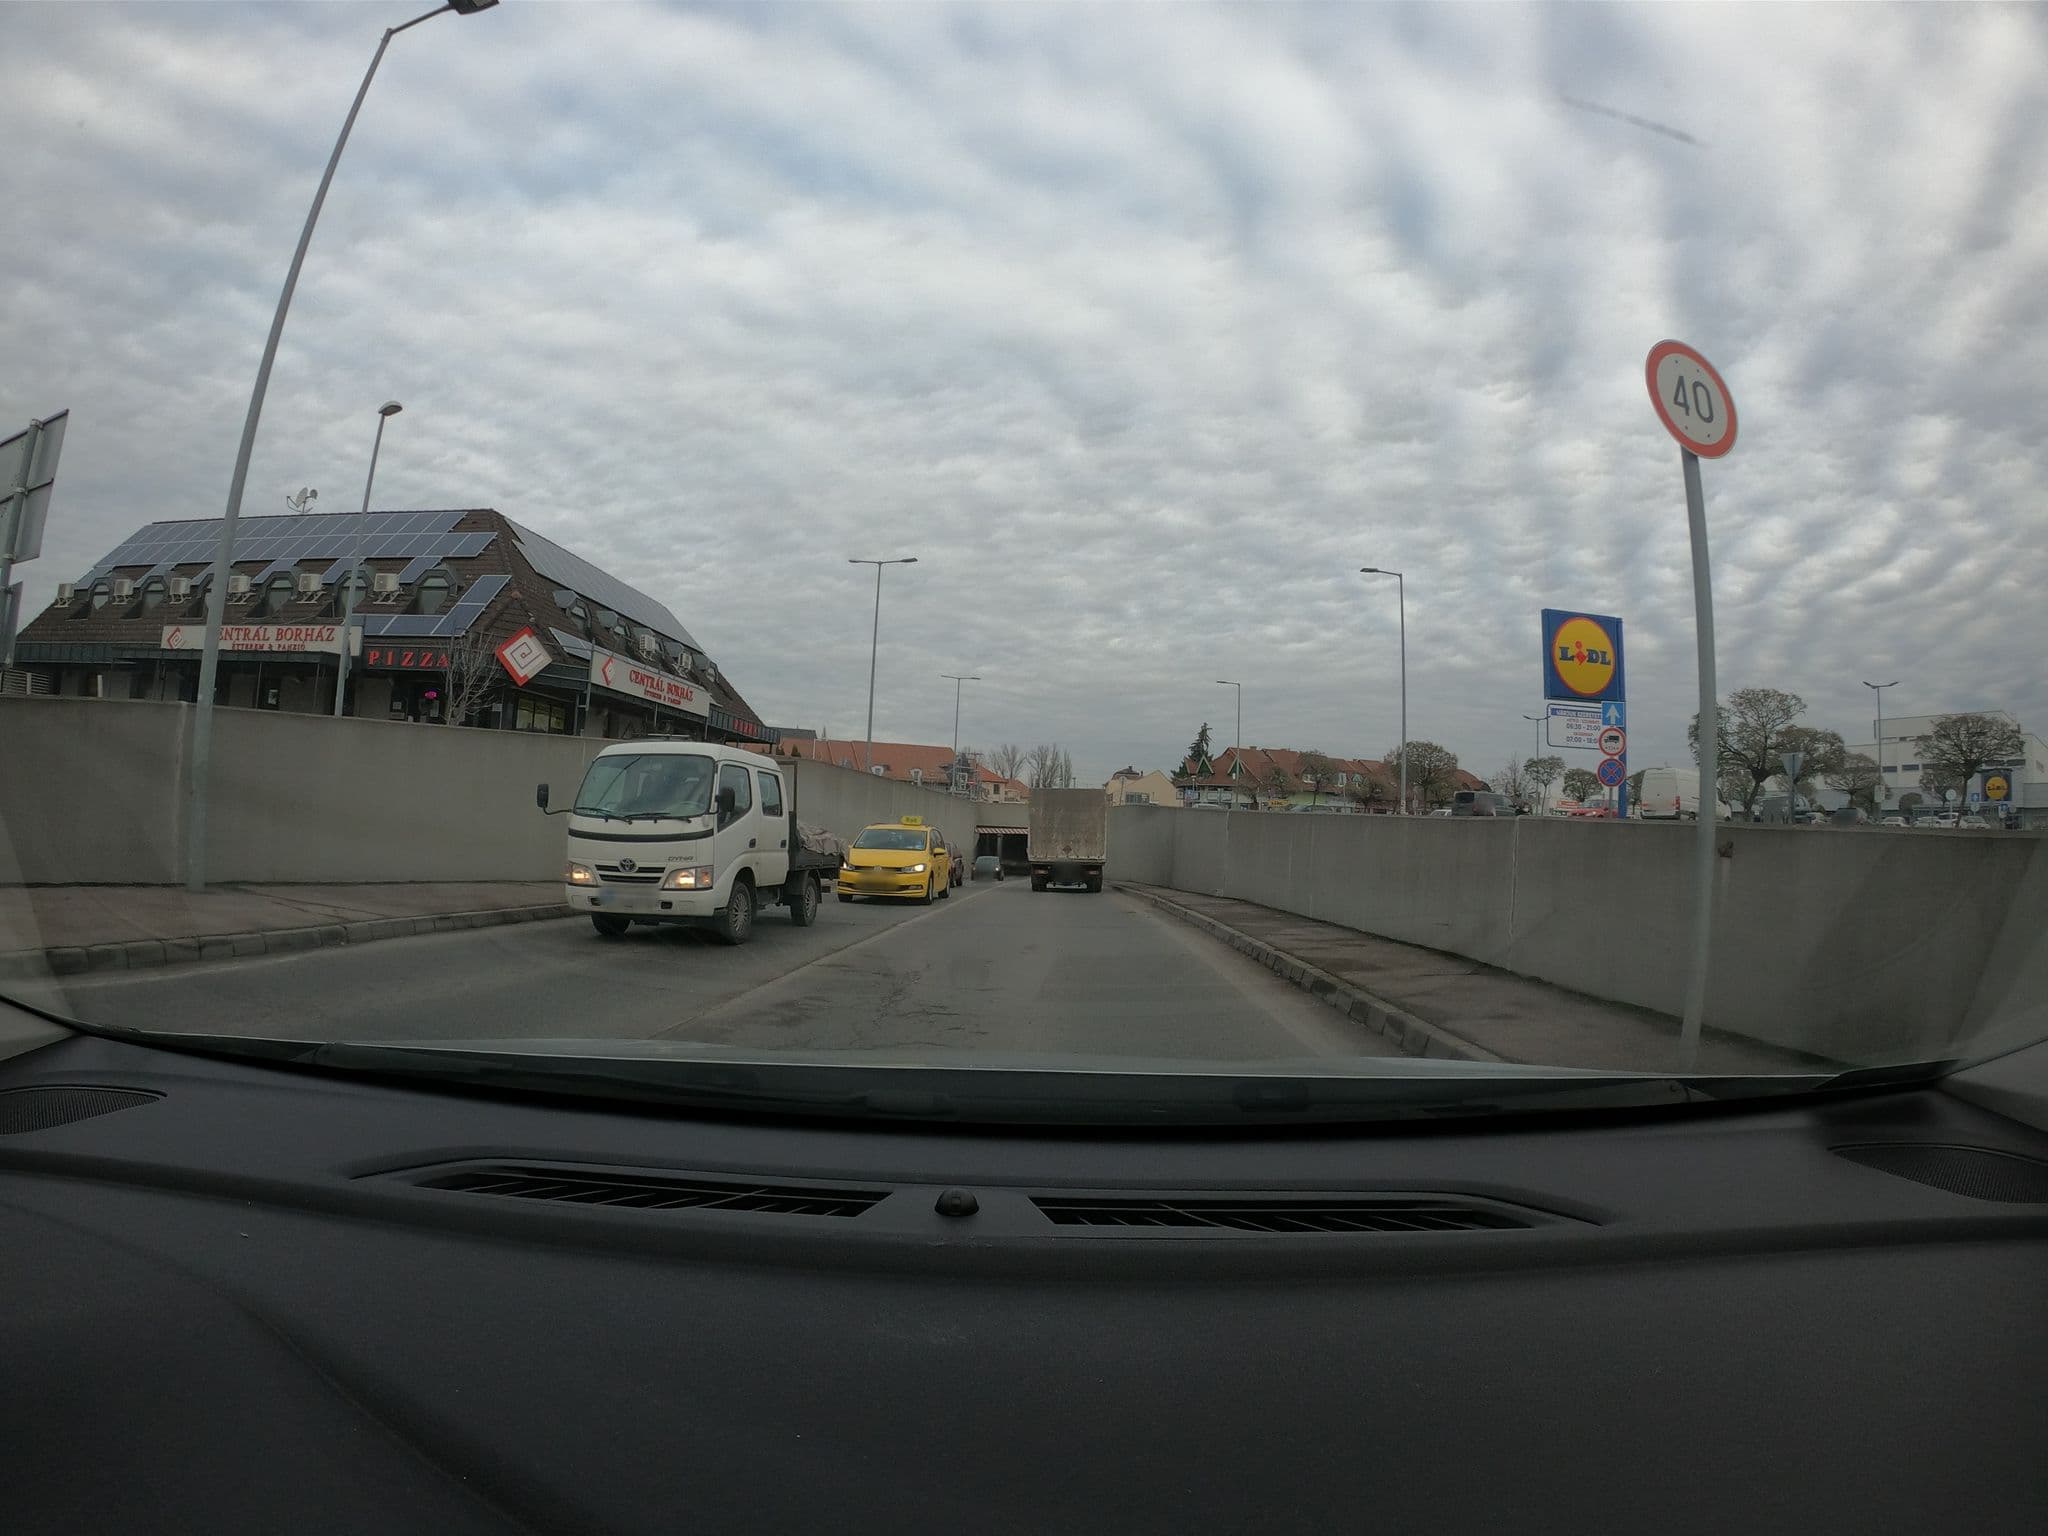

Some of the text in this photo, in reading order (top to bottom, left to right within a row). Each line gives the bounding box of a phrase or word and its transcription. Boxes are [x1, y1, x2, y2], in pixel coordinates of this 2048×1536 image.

[1673, 375, 1714, 424] 40
[218, 625, 336, 642] ENTRÁL BORHÁZ
[367, 650, 449, 667] PIZZA
[629, 669, 665, 692] CENTRÁL
